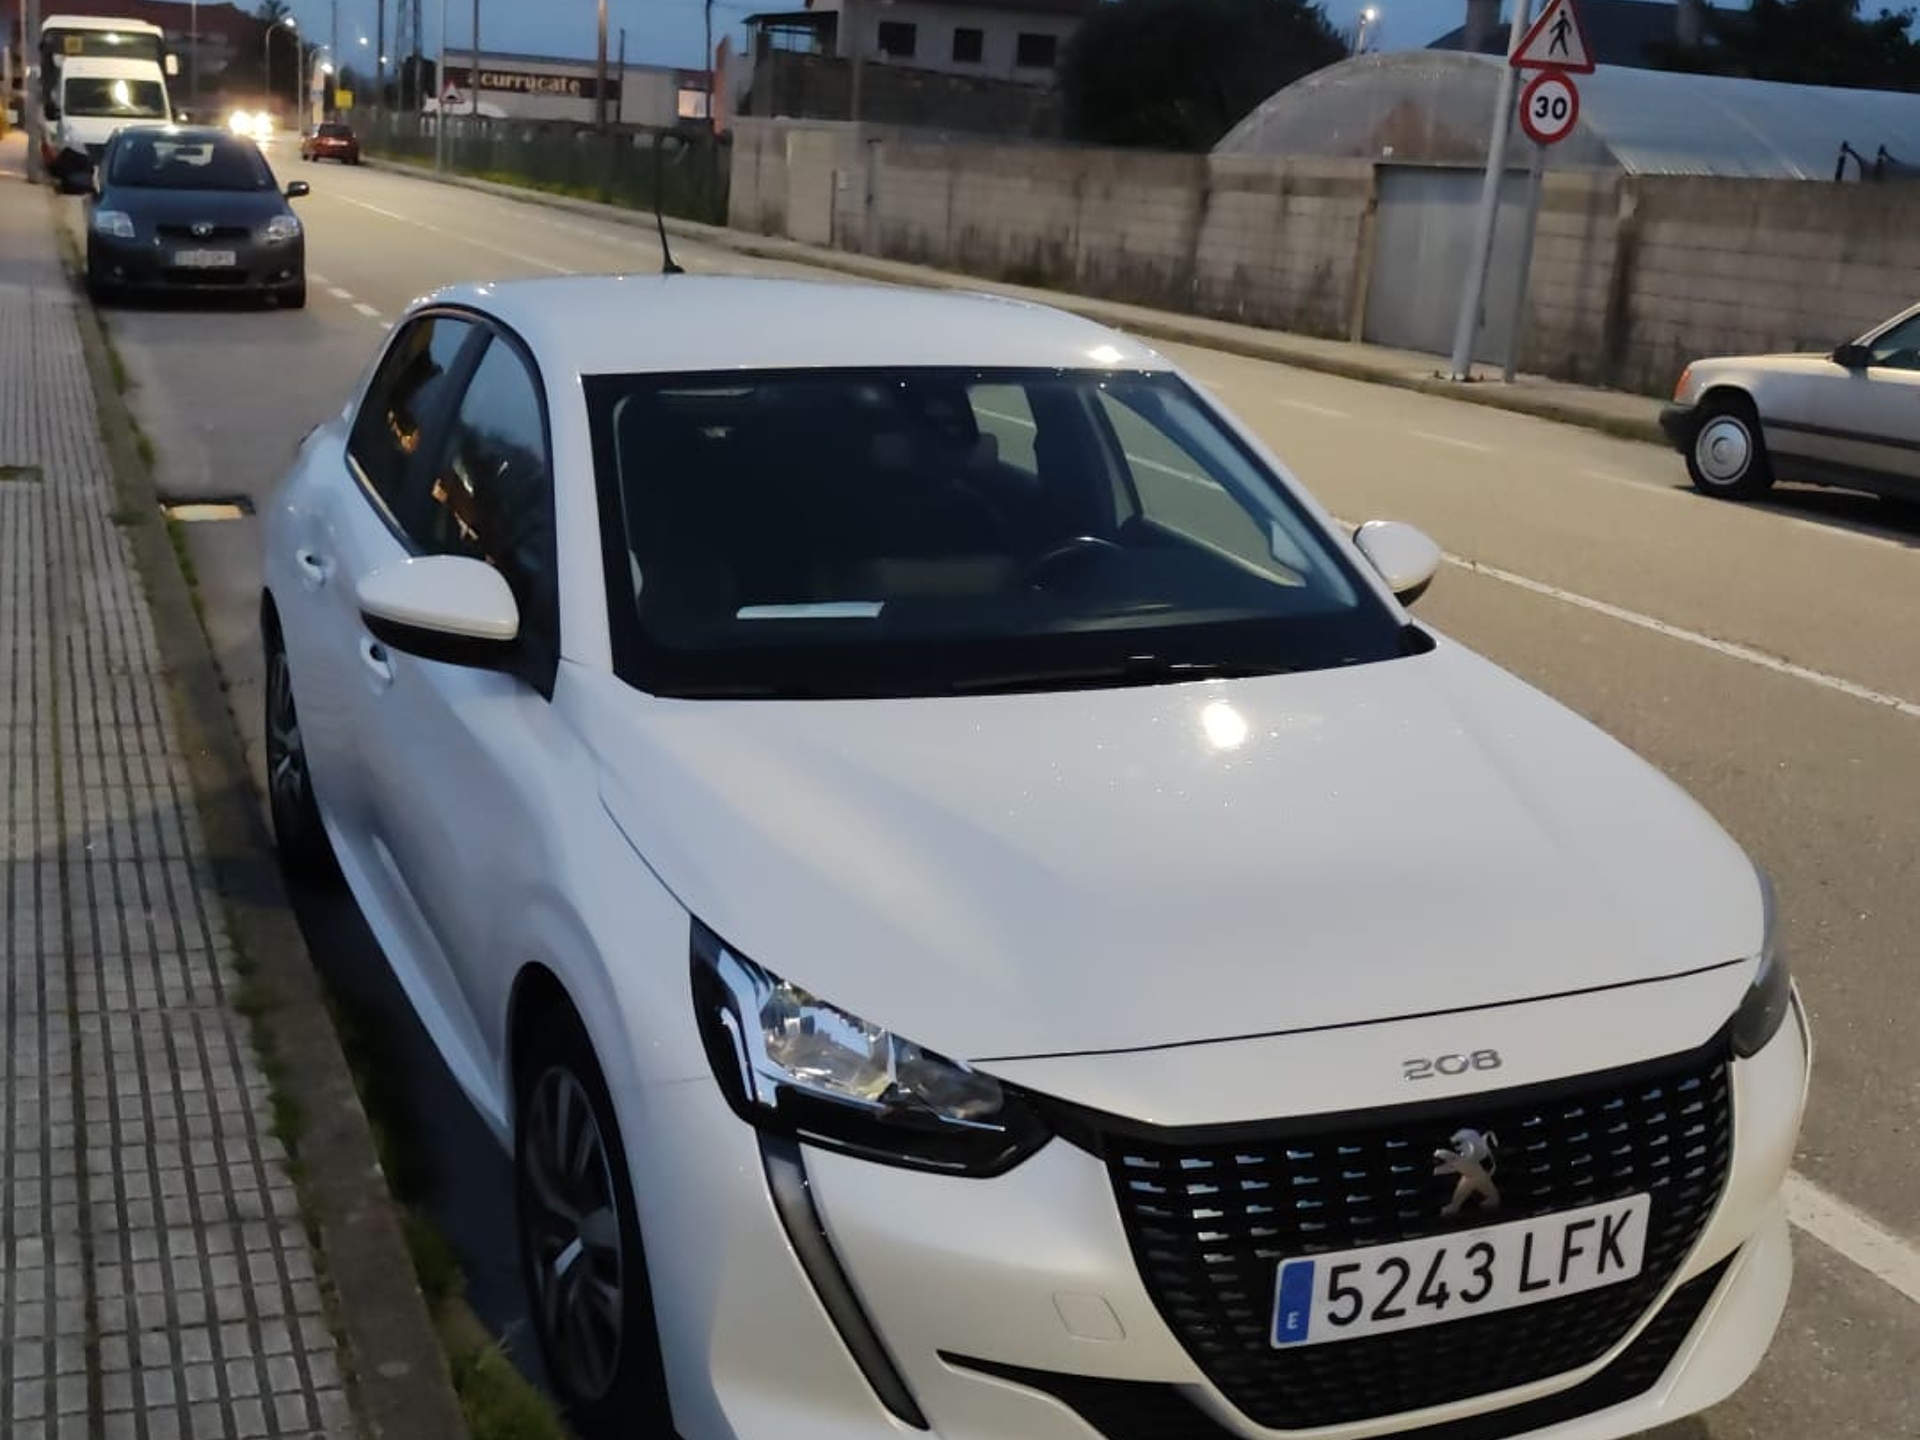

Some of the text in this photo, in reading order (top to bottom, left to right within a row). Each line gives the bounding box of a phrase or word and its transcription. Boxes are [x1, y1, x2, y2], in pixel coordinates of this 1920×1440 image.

[1535, 95, 1567, 120] 30
[1402, 1049, 1503, 1080] 208
[1286, 1209, 1633, 1329] E 5243 LFK
